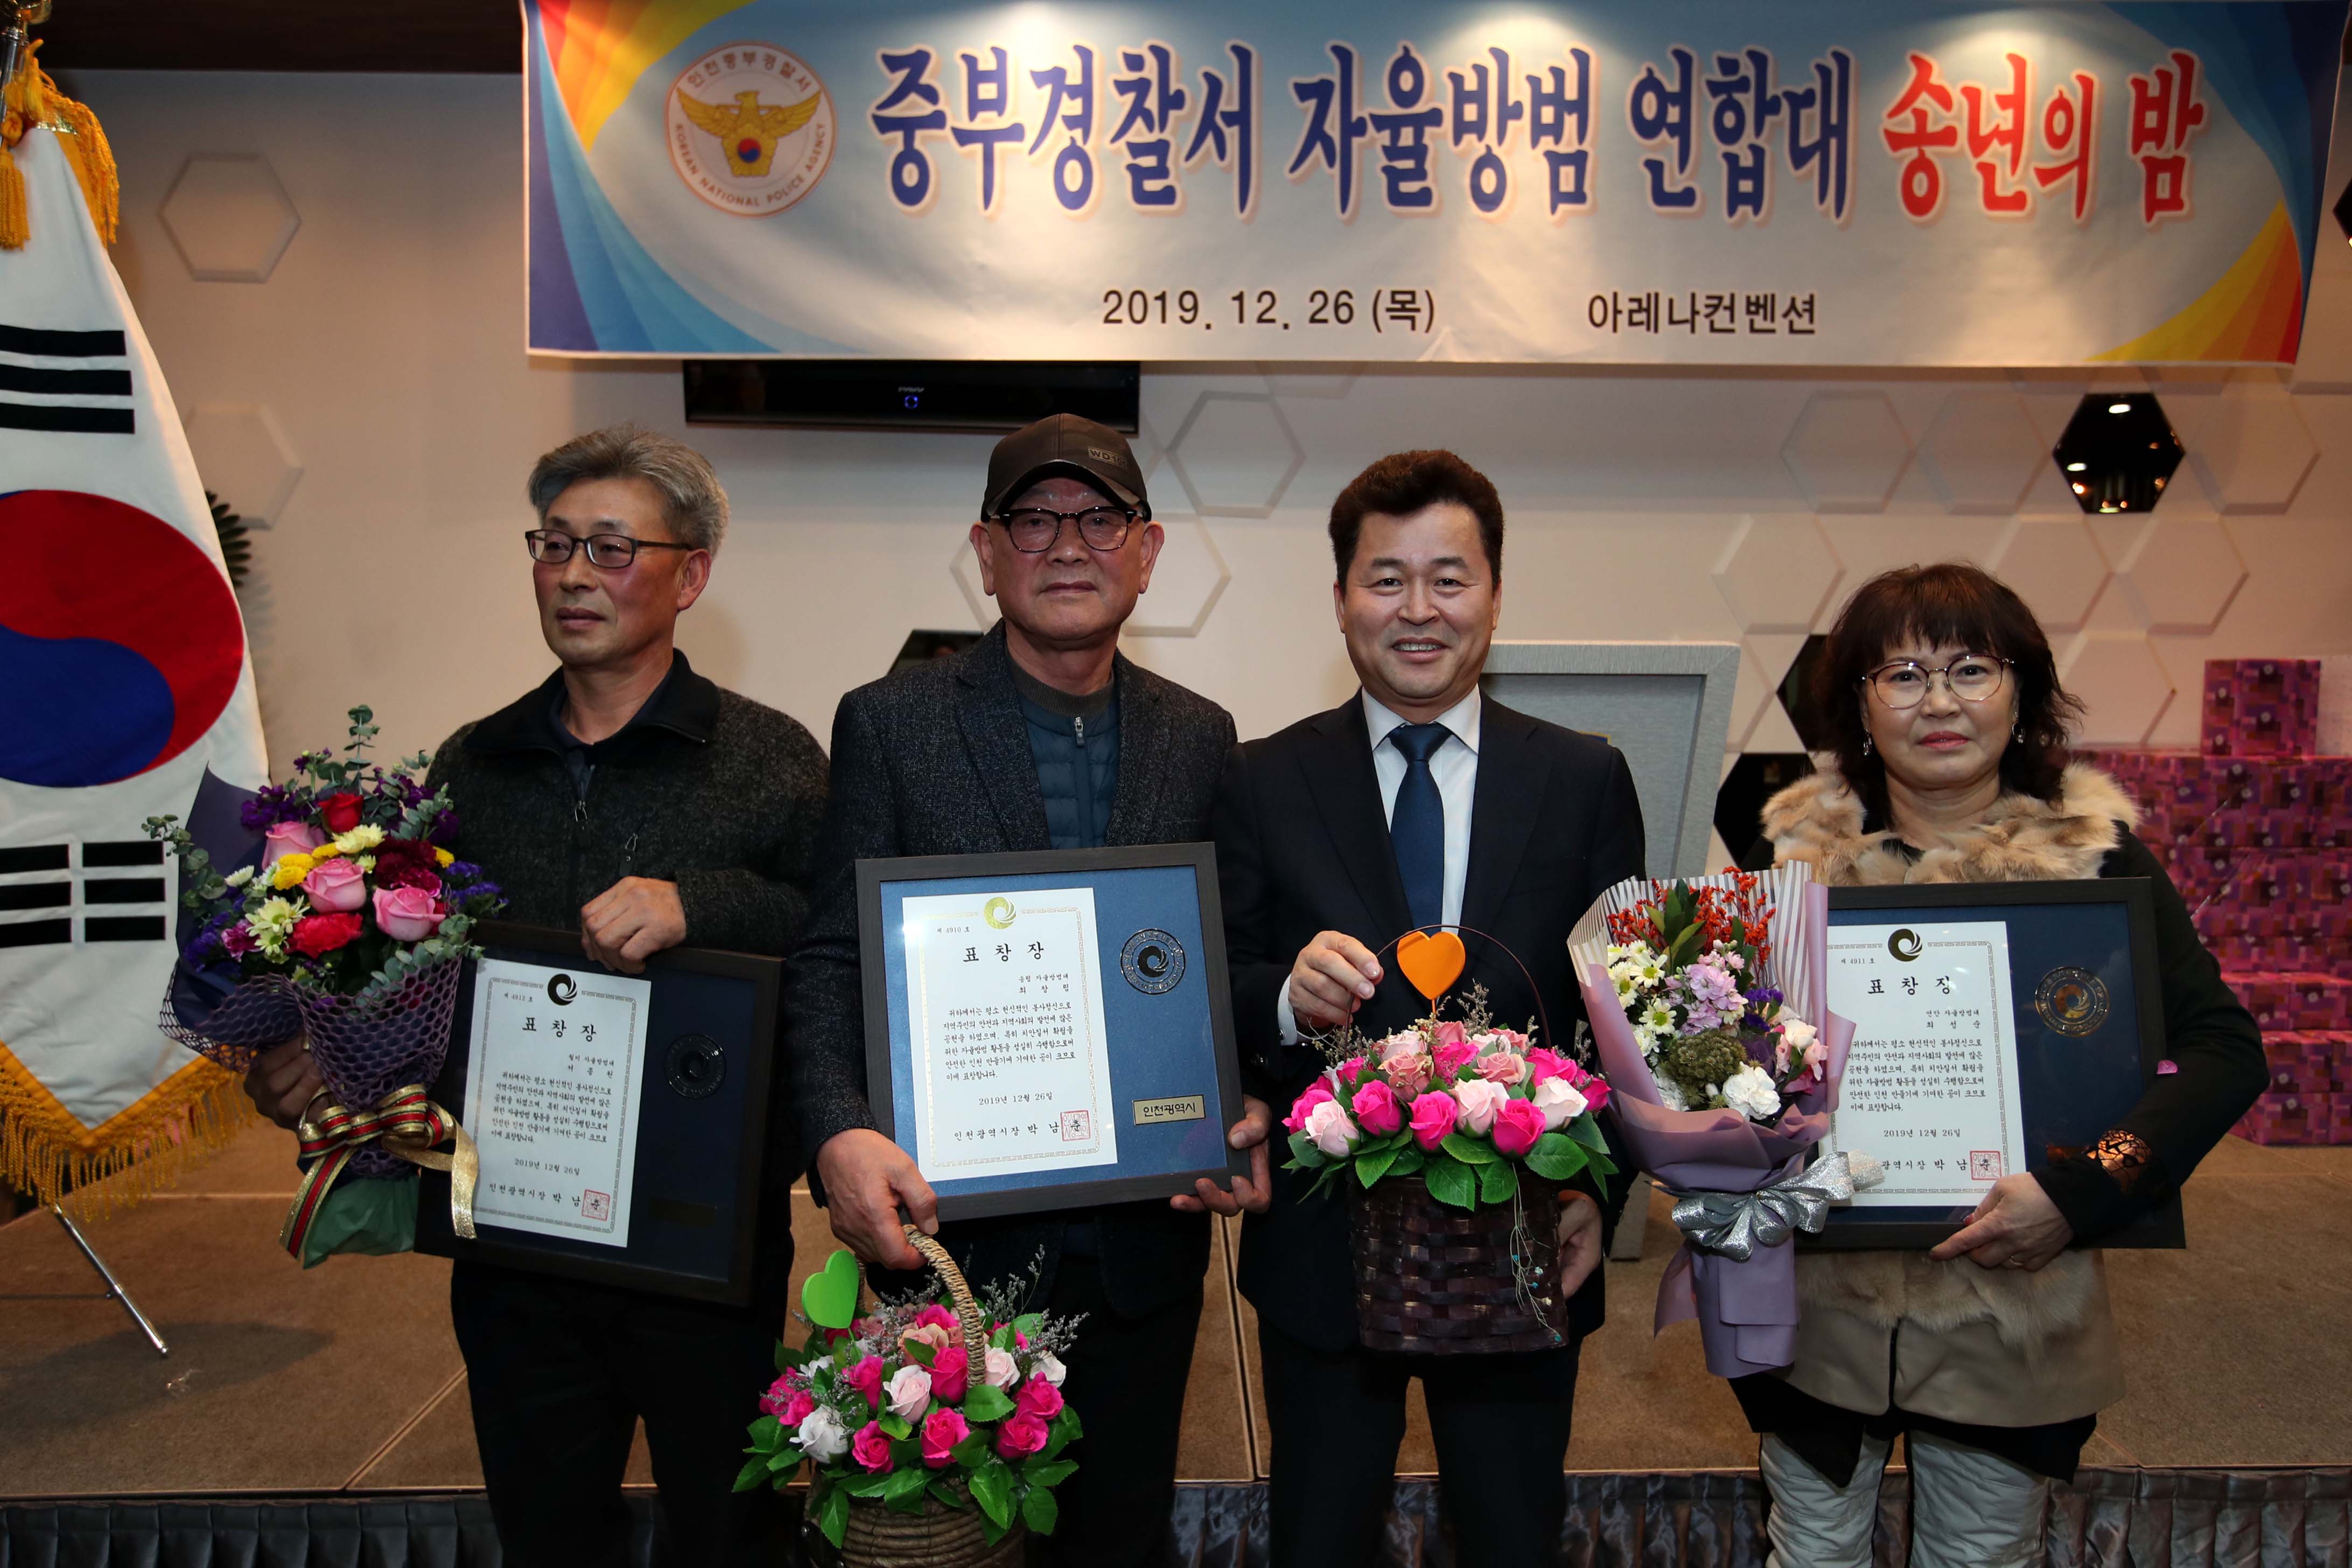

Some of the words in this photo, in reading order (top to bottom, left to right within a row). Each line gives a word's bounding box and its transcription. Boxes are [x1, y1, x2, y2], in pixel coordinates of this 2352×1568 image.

[871, 45, 1252, 214] 중부경찰서
[1289, 44, 1590, 215] 자율방범
[1630, 48, 1850, 218] 연합대
[1883, 53, 2094, 220] 송년의
[2130, 53, 2204, 223] 밤
[676, 123, 699, 175] KOREAN
[699, 178, 760, 206] NATIONAL
[766, 174, 805, 203] POLICE
[806, 123, 825, 172] AGENCY
[1103, 290, 1212, 330] 2019.
[1231, 290, 1290, 330] 12.
[1308, 289, 1355, 325] 26
[1372, 289, 1436, 333] (목)
[1588, 291, 1816, 334] 아레나컨벤션
[1143, 1102, 1196, 1117] 인천광역시
